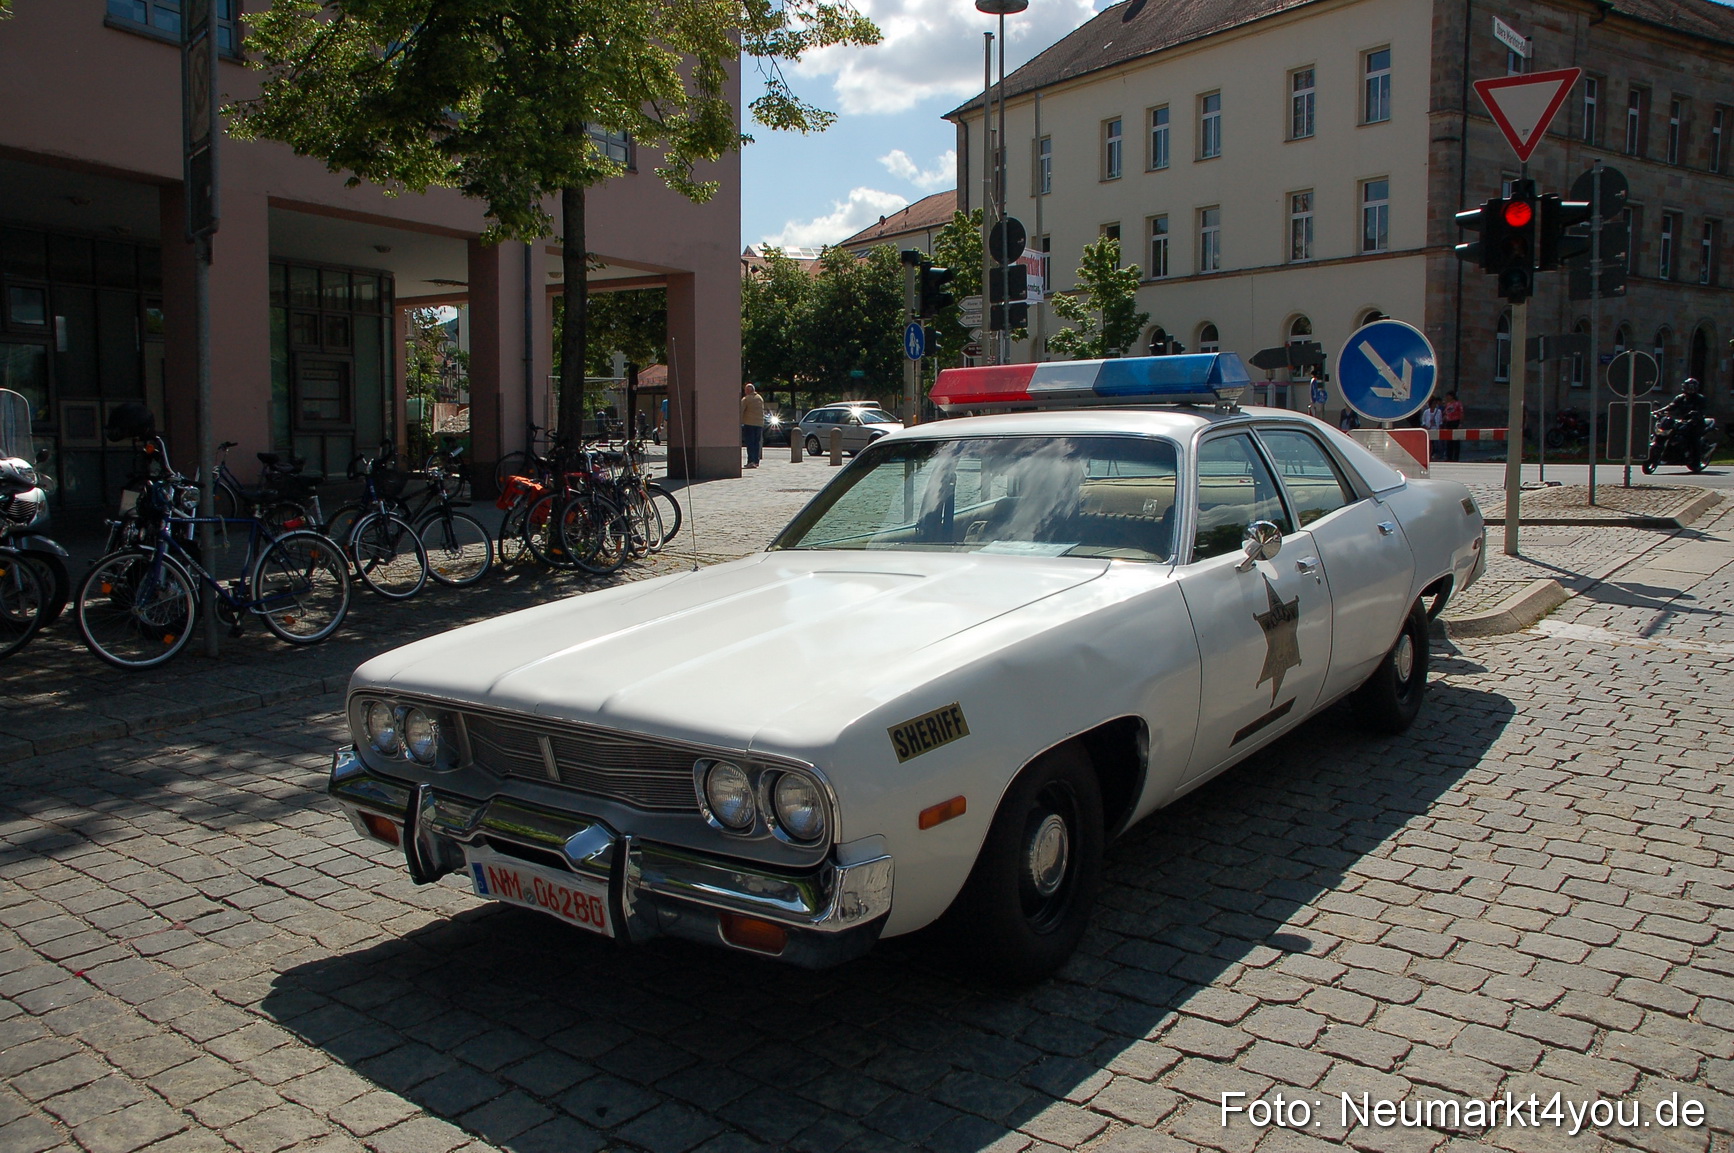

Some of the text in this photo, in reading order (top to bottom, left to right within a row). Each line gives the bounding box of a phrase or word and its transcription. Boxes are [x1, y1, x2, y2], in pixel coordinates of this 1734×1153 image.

[893, 707, 962, 758] SHERIFF
[488, 866, 606, 928] NM 06280
